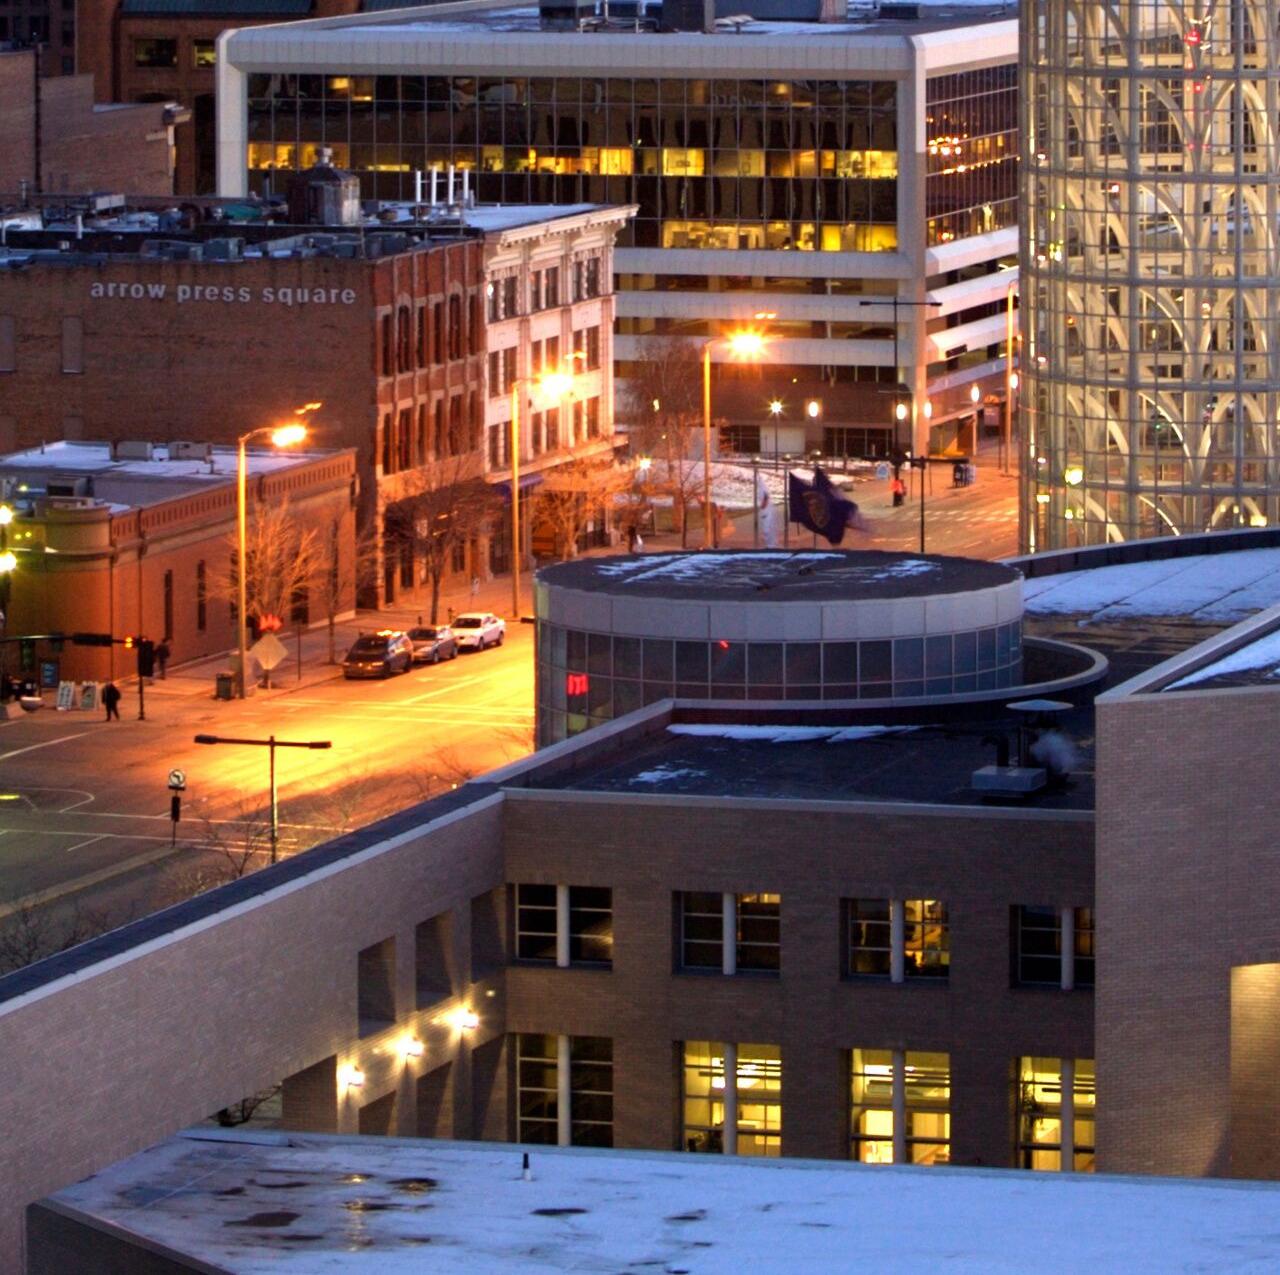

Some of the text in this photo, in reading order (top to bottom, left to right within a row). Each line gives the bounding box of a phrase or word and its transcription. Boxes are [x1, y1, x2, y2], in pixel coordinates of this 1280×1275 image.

[90, 282, 357, 306] arrow press square
